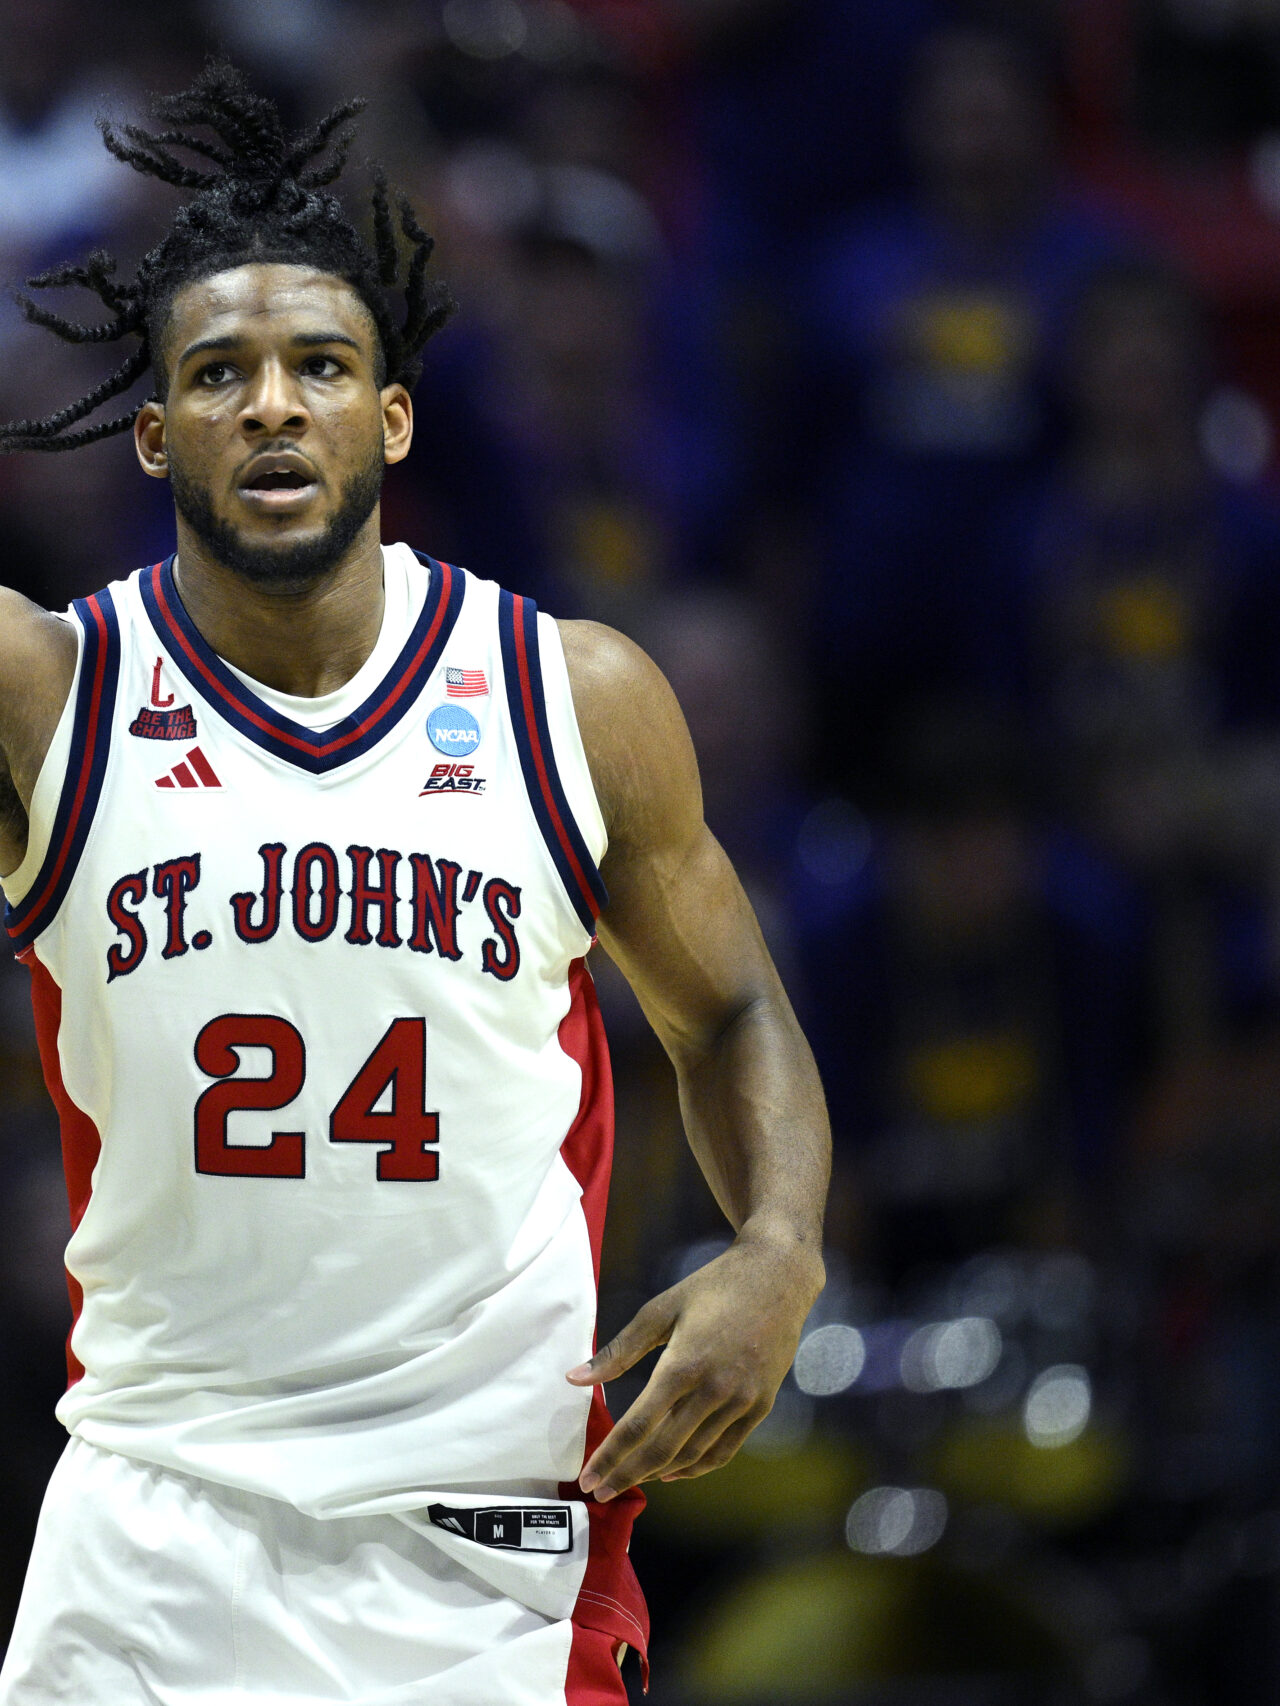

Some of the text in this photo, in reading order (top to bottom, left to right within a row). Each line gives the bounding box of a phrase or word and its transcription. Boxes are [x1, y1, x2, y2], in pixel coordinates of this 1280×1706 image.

[139, 706, 192, 726] BE THE
[131, 722, 196, 739] CHANGE
[435, 728, 479, 743] NCAA
[430, 763, 475, 778] BIG
[423, 776, 486, 791] EAST
[106, 842, 522, 984] ST. JOHN'S
[193, 1012, 440, 1182] 24
[493, 1524, 504, 1539] M
